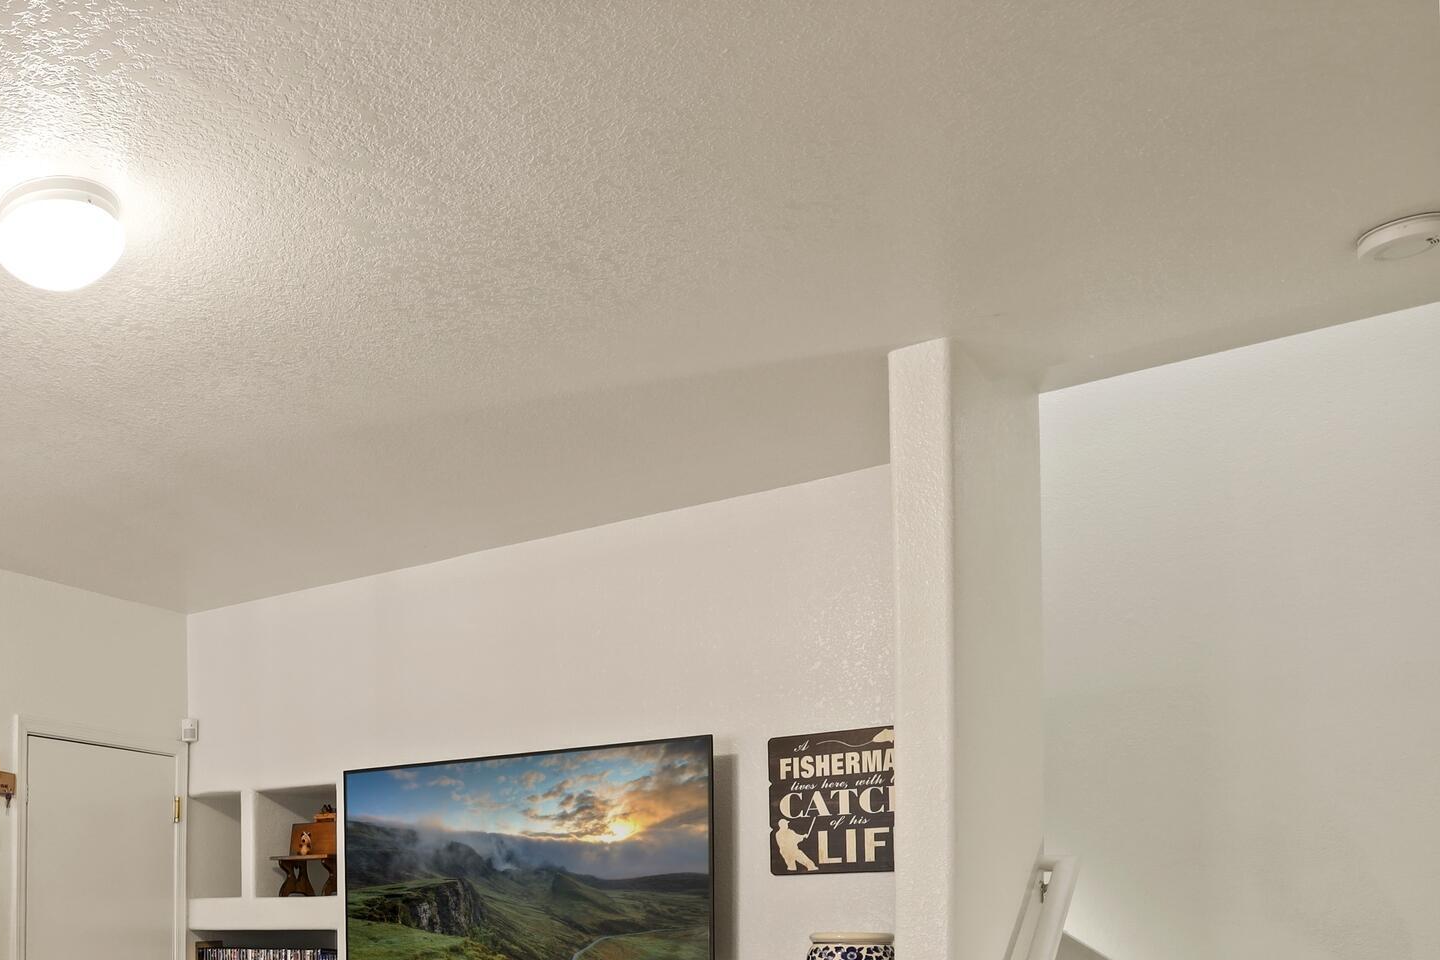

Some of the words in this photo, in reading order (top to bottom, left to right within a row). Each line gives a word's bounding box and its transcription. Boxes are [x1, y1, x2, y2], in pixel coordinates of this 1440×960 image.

[794, 740, 809, 751] A
[791, 781, 817, 791] lives
[856, 774, 884, 786] with
[830, 817, 845, 829] of
[849, 815, 870, 825] his
